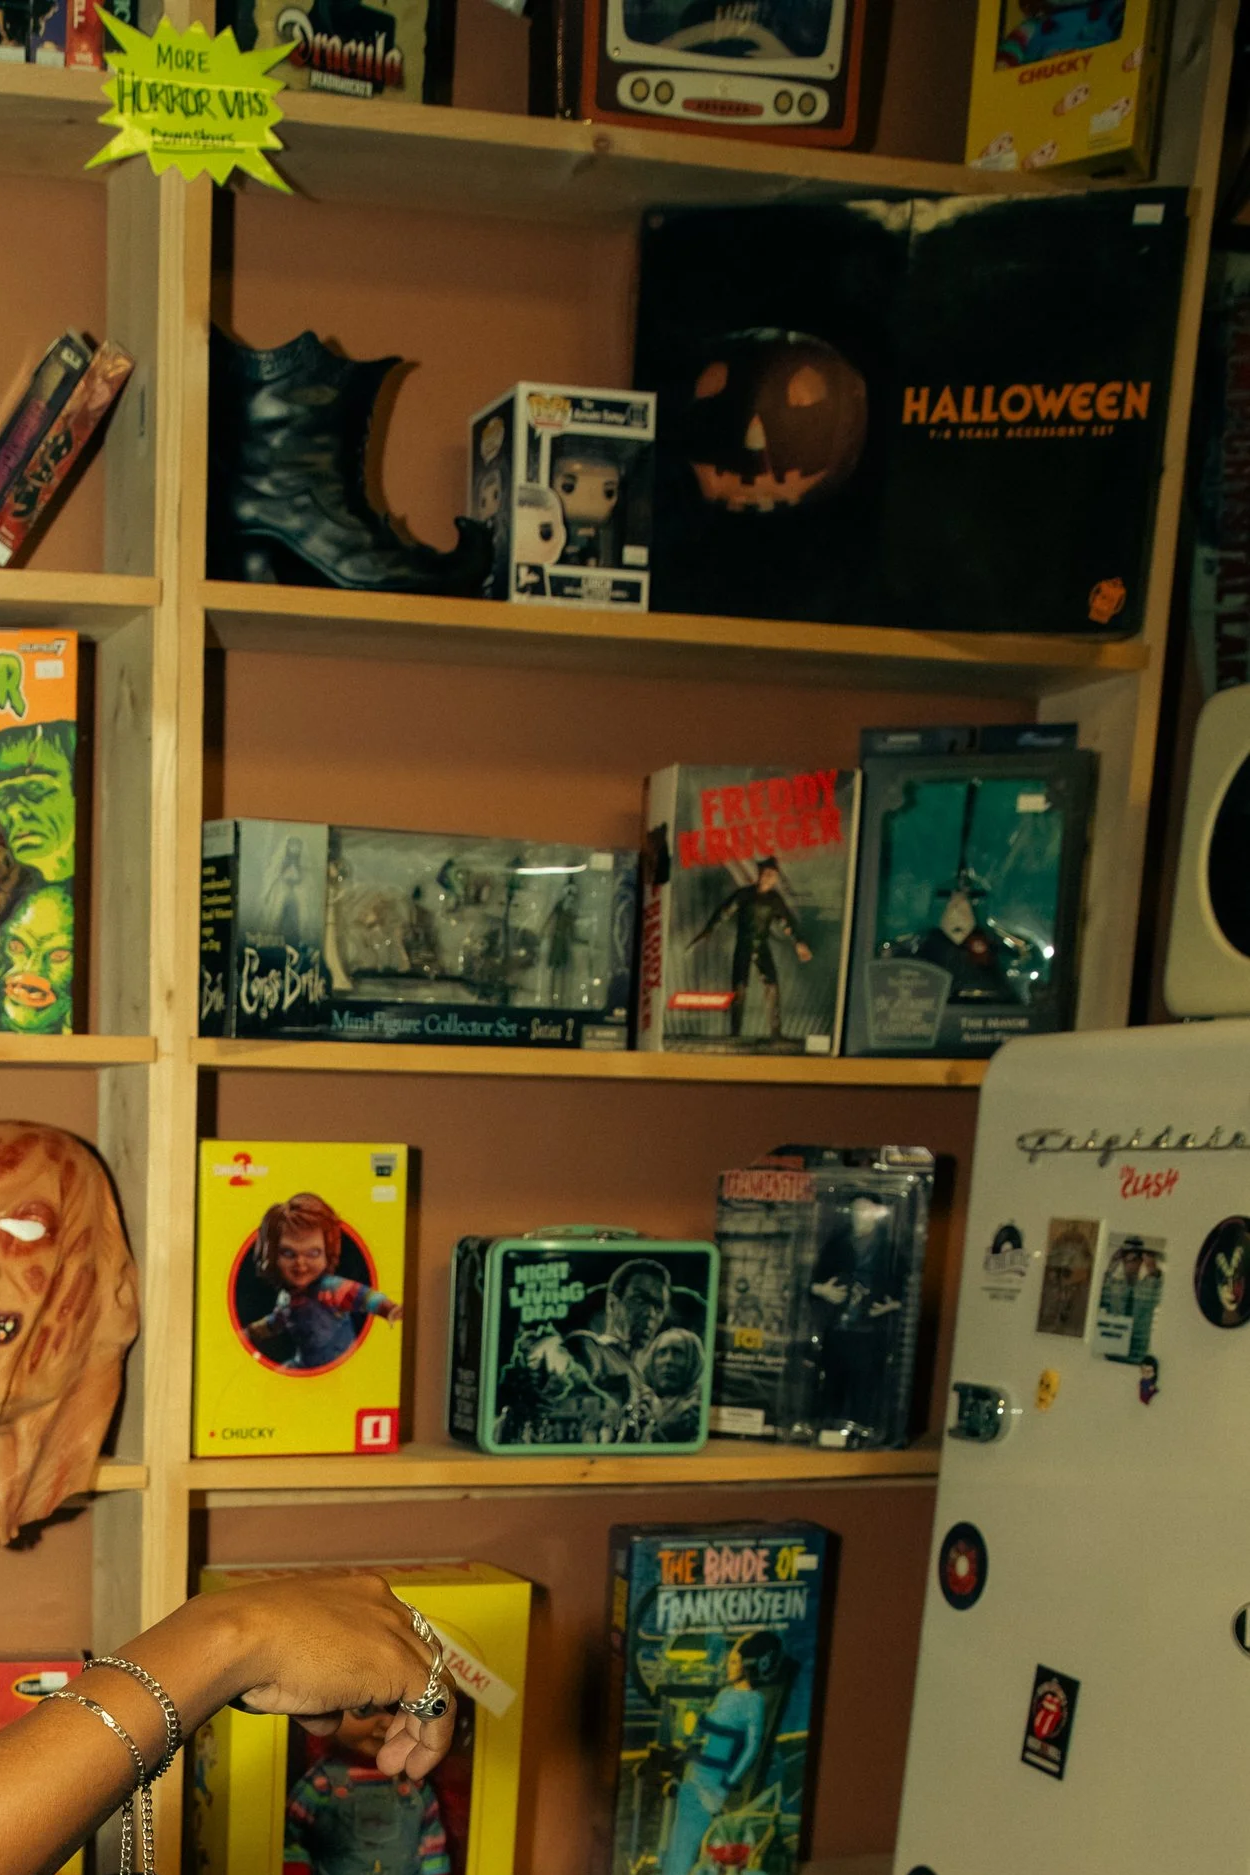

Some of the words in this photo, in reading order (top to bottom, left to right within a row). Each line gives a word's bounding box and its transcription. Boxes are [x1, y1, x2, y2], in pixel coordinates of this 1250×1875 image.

[157, 45, 211, 74] MORE
[278, 8, 404, 88] Dracula
[1016, 53, 1094, 86] CHUCKY
[117, 68, 218, 120] HORROR
[223, 89, 269, 121] VHS
[151, 129, 236, 149] Downstairs
[902, 380, 1151, 425] HALLOWEEN
[958, 427, 1000, 440] SCALE
[1006, 426, 1086, 439] ACCESSORY
[1091, 424, 1115, 437] SET
[700, 768, 839, 828] FREDDY
[678, 806, 844, 869] KRUEGER
[282, 944, 327, 1014] Bride
[330, 1009, 370, 1032] Mini
[371, 1011, 421, 1037] Figure
[423, 1012, 493, 1034] Collector
[494, 1017, 518, 1037] Set
[529, 1017, 561, 1041] Series
[564, 1017, 575, 1042] 2
[1016, 1123, 1249, 1168] Frigidair
[228, 1152, 254, 1187] 2
[1119, 1167, 1180, 1200] CLASH
[514, 1261, 571, 1282] NIGHT
[508, 1281, 586, 1307] LIVING
[519, 1304, 568, 1324] DEAD
[221, 1427, 275, 1441] CHUCKY
[658, 1550, 697, 1585] THE
[703, 1545, 770, 1585] BRIDE
[775, 1546, 807, 1582] OF
[655, 1586, 810, 1631] FRANKENSTEIN
[450, 1648, 492, 1693] TALK!
